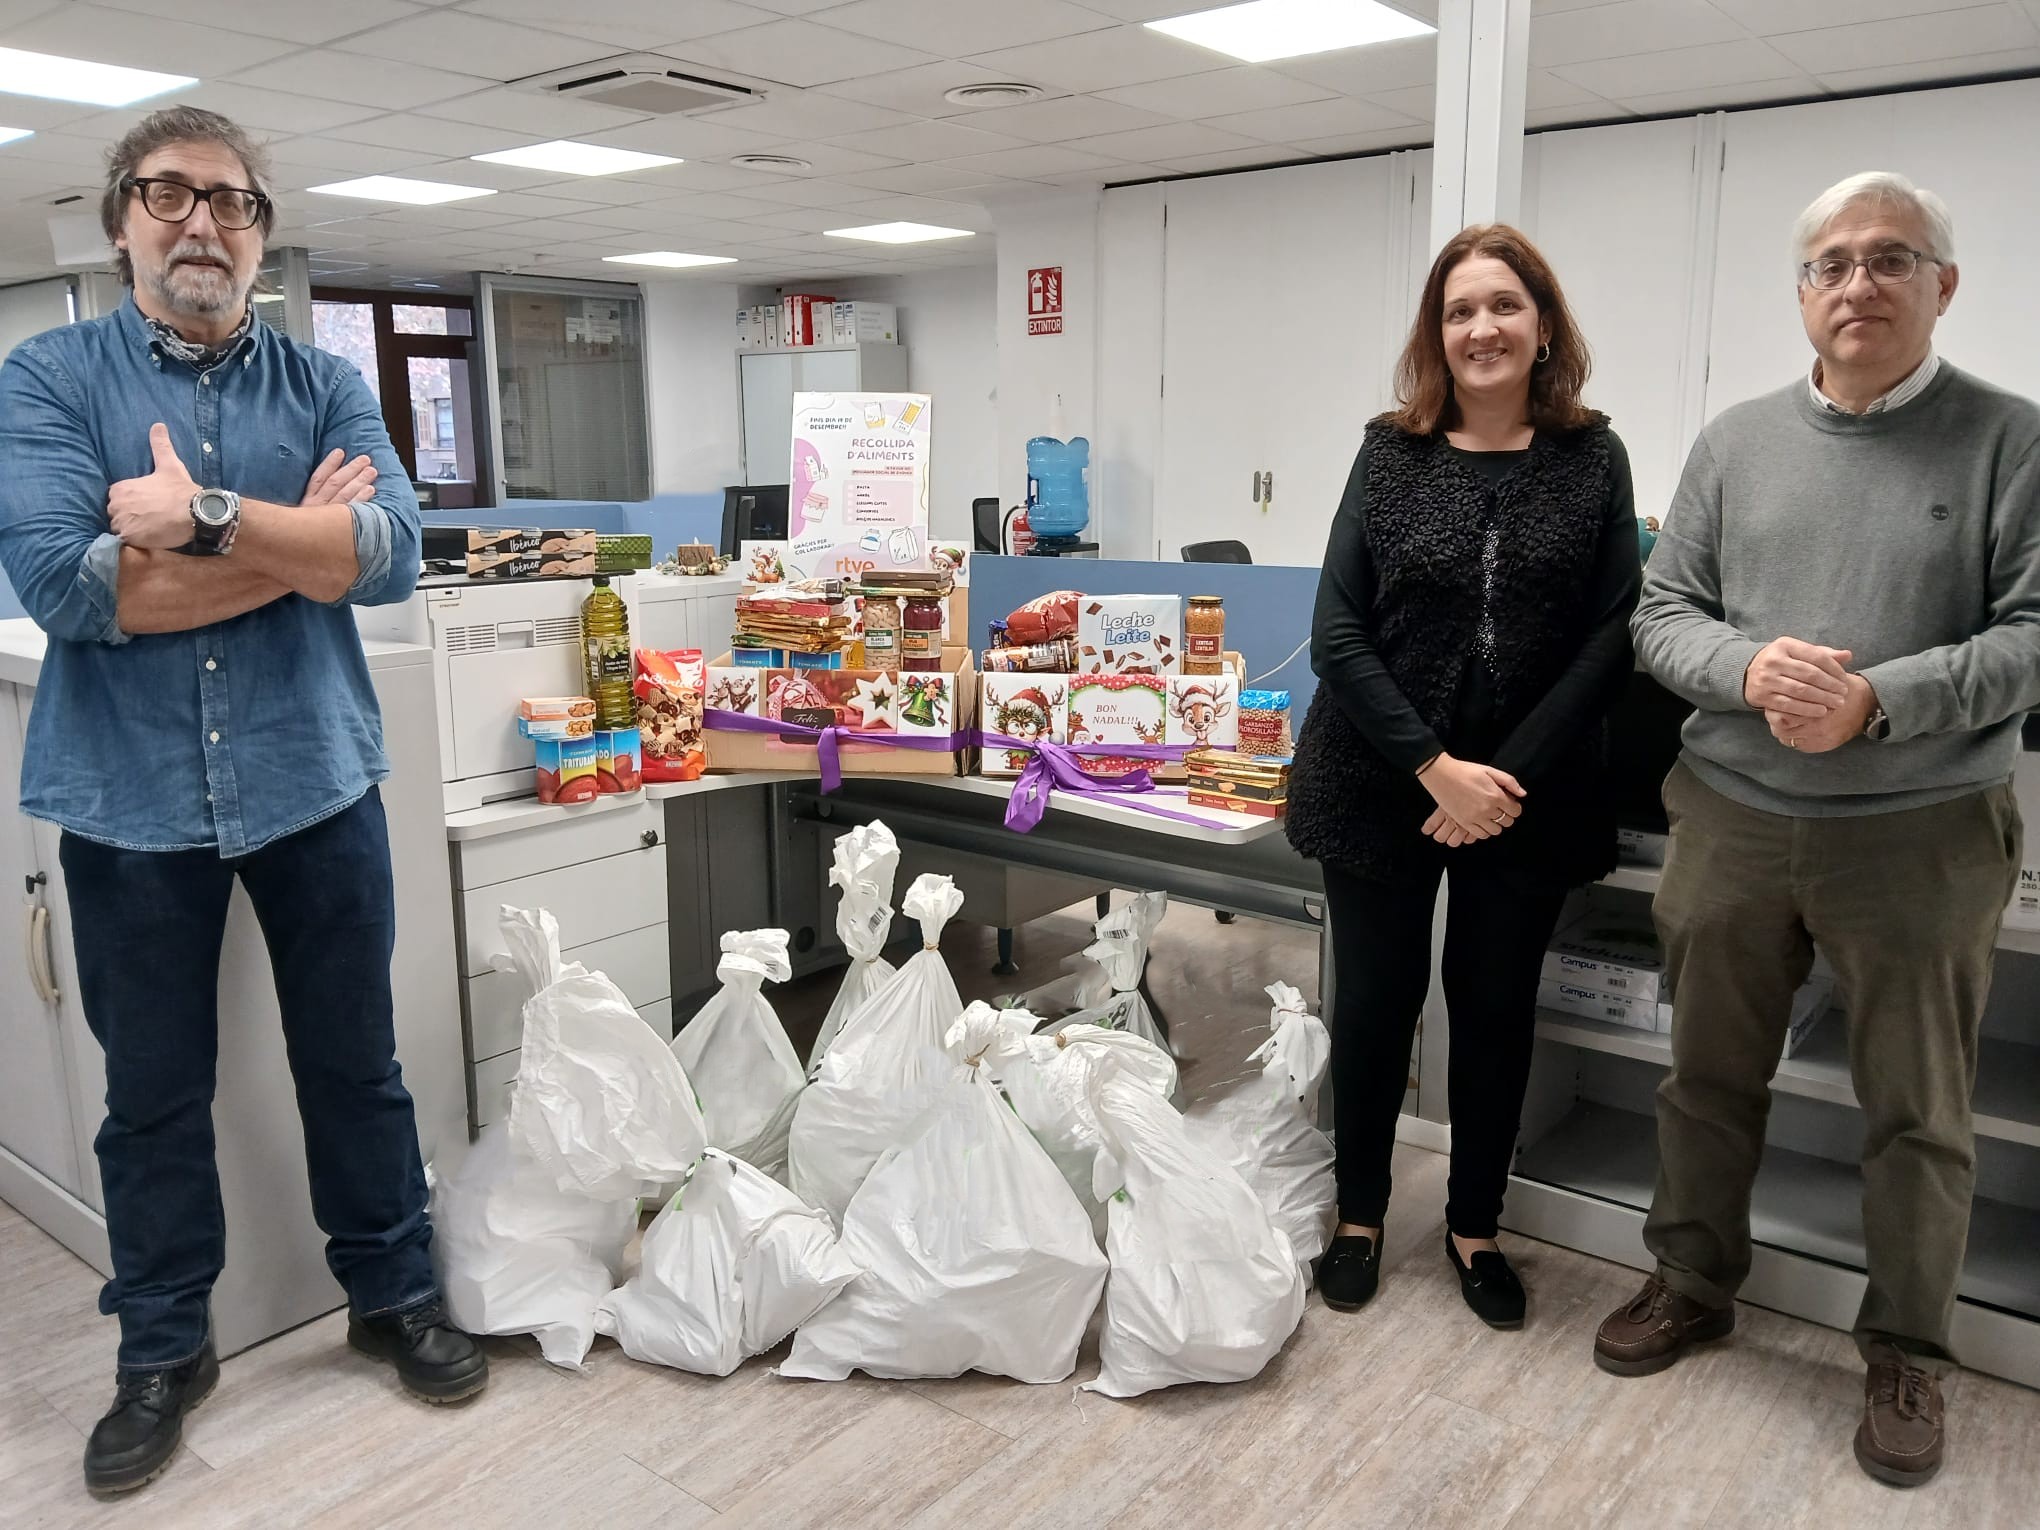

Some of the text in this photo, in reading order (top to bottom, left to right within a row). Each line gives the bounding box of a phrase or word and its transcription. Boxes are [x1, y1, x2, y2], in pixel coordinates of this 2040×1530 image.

[1029, 319, 1061, 333] EXTINTOR
[852, 438, 915, 448] RECOLLIDA
[847, 451, 915, 461] D'ALIMENTS
[836, 556, 875, 574] rtve
[1101, 611, 1155, 630] Leche
[1105, 628, 1151, 646] Leite
[1096, 704, 1118, 713] BON
[792, 713, 819, 723] Feliz
[1092, 716, 1139, 725] NADAL!!!
[563, 753, 597, 769] TRITURAD
[1560, 955, 1597, 970] Campus
[1559, 985, 1596, 1000] Campus
